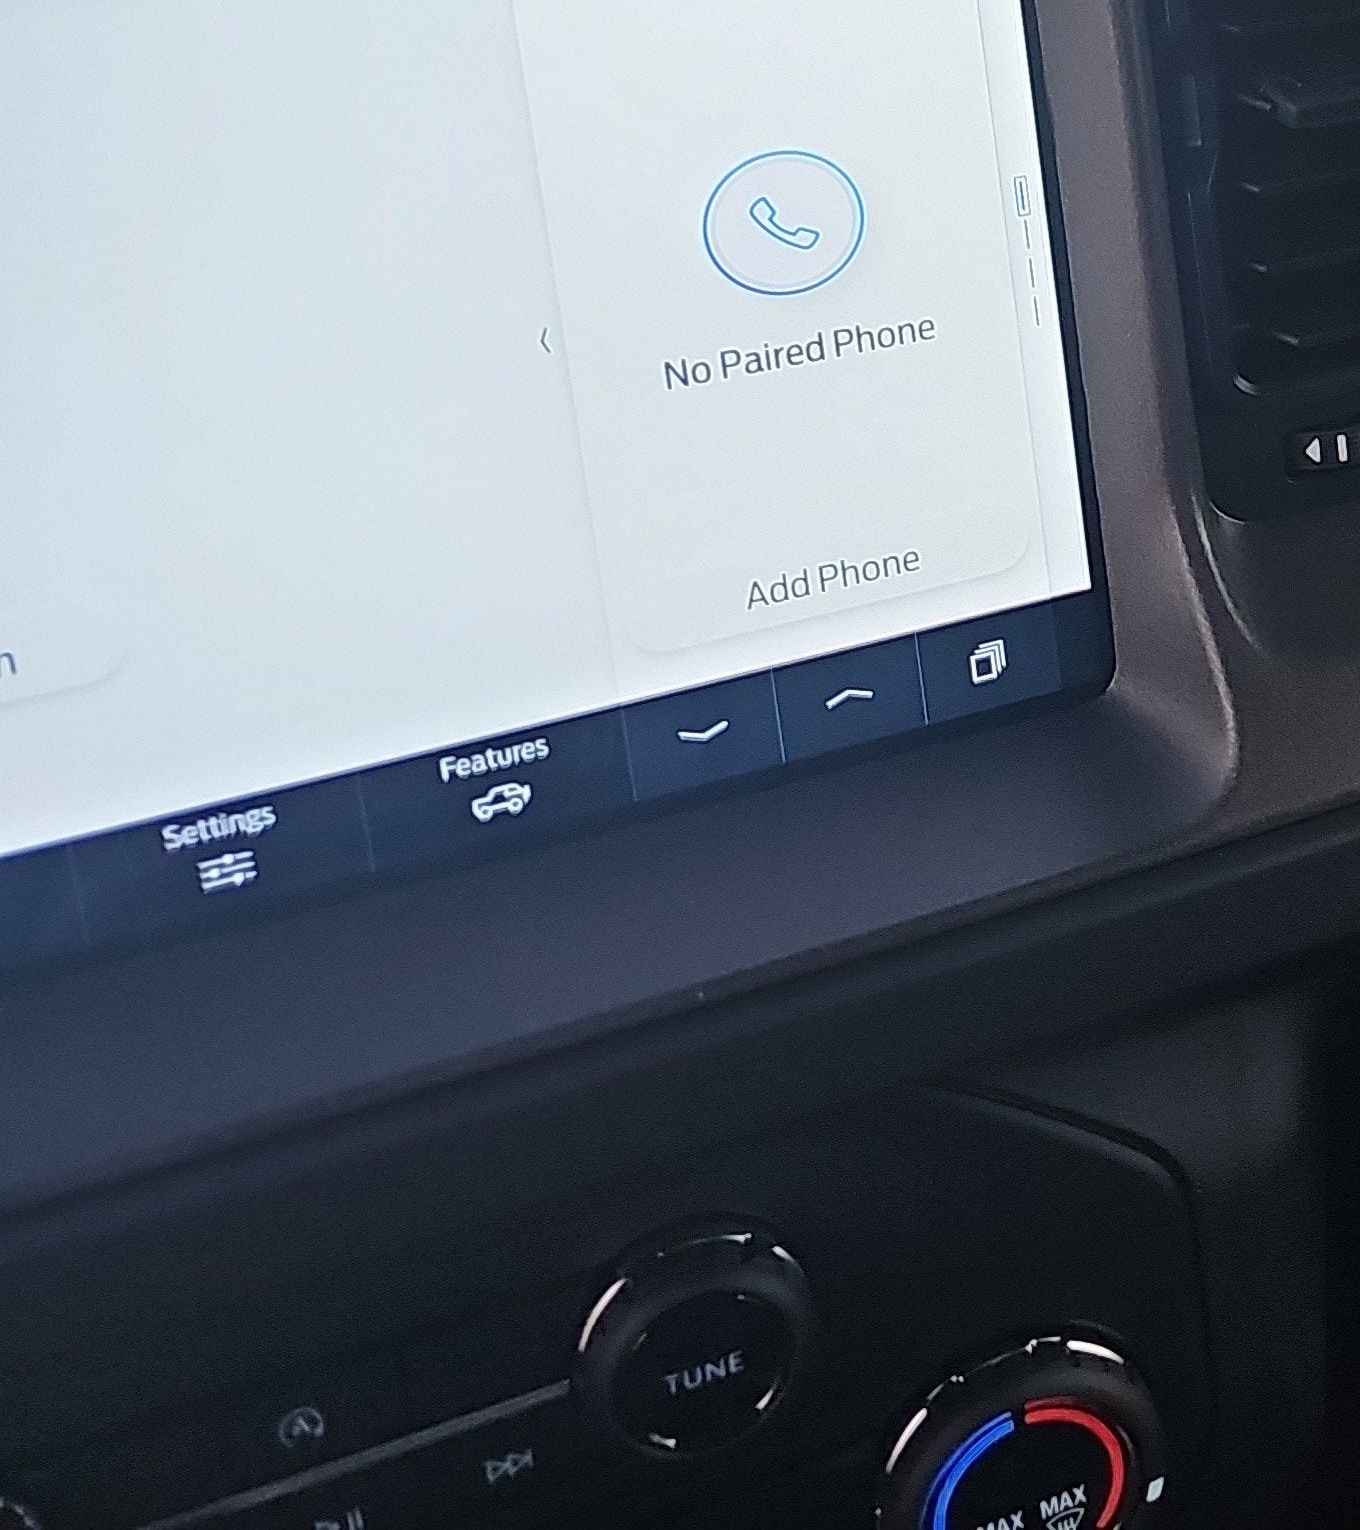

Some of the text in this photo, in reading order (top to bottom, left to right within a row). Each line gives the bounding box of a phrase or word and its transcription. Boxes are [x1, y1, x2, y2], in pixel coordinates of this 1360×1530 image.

[664, 319, 936, 390] No Paired Phone
[747, 551, 920, 610] Add Phone
[438, 737, 550, 783] Features
[162, 805, 277, 851] Settings
[665, 1351, 744, 1395] TUNE
[976, 1510, 1024, 1530] AX
[1040, 1484, 1087, 1519] MAX
